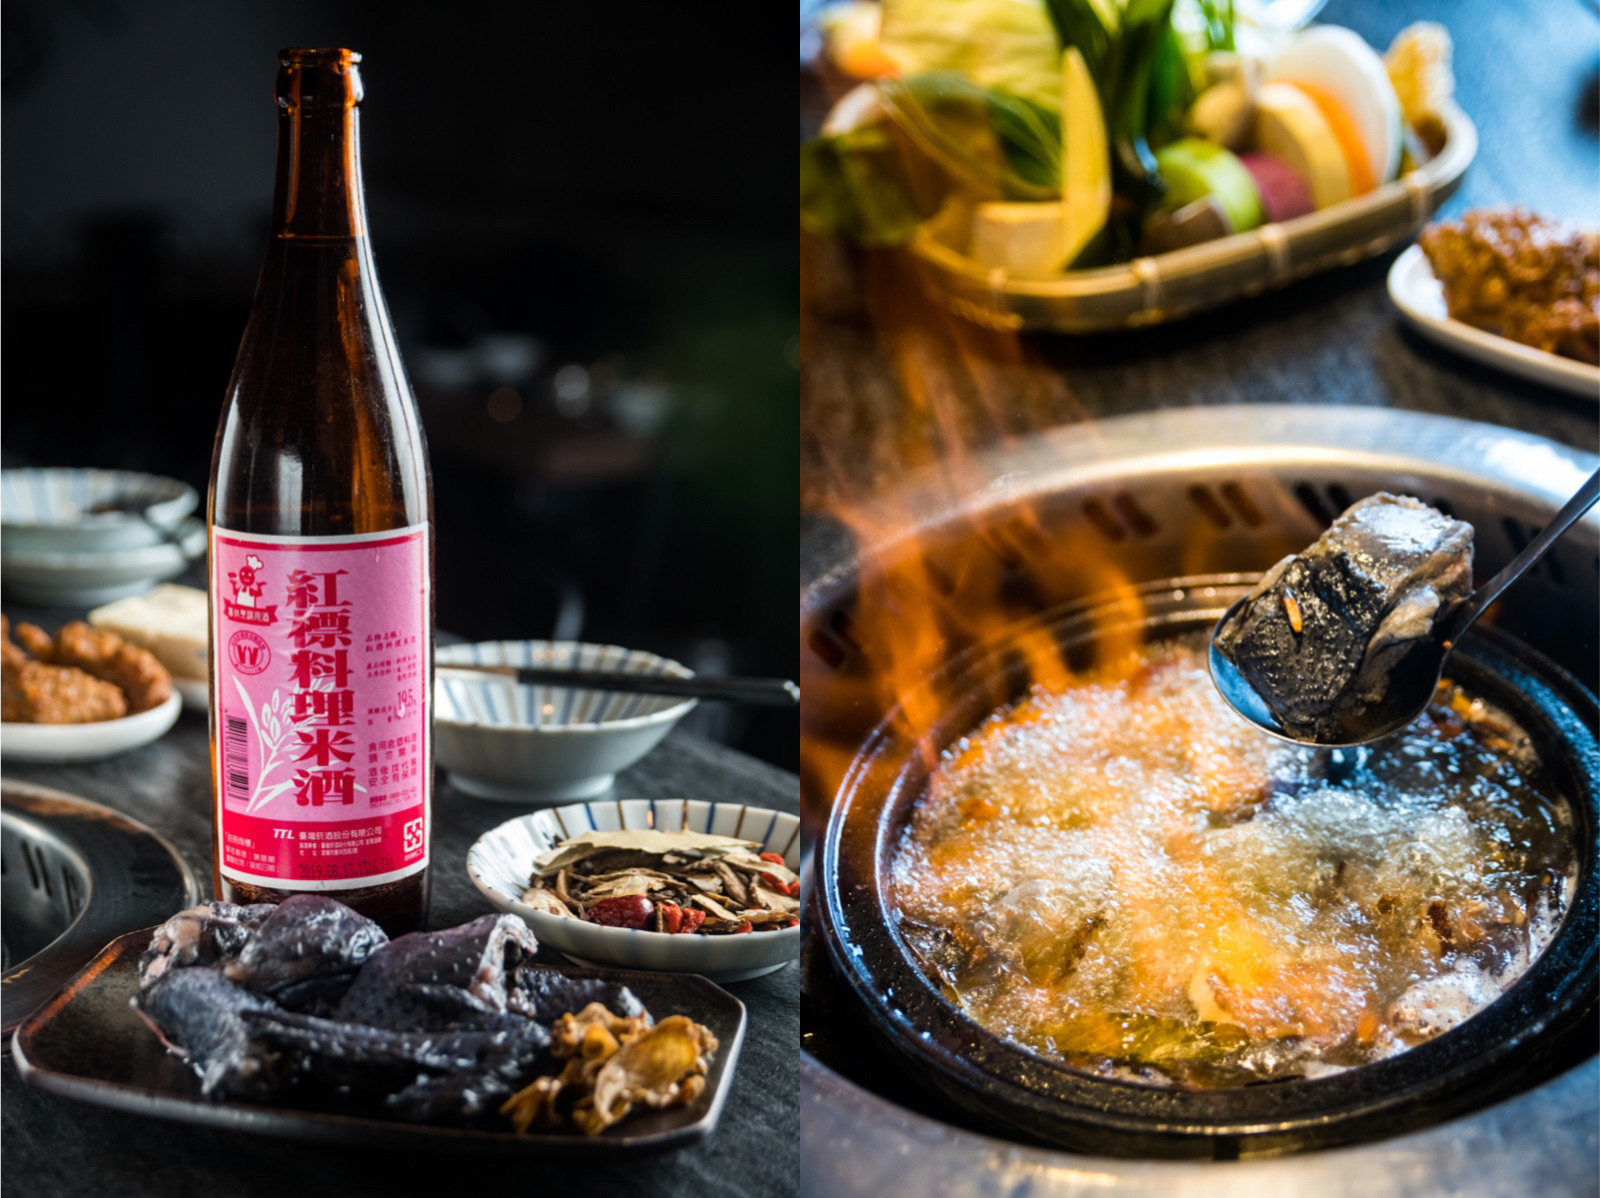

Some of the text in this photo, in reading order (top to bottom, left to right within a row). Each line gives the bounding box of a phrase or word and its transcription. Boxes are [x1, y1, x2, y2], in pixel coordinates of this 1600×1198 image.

[286, 569, 356, 807] 紅標料理米酒
[273, 828, 296, 840] TTL
